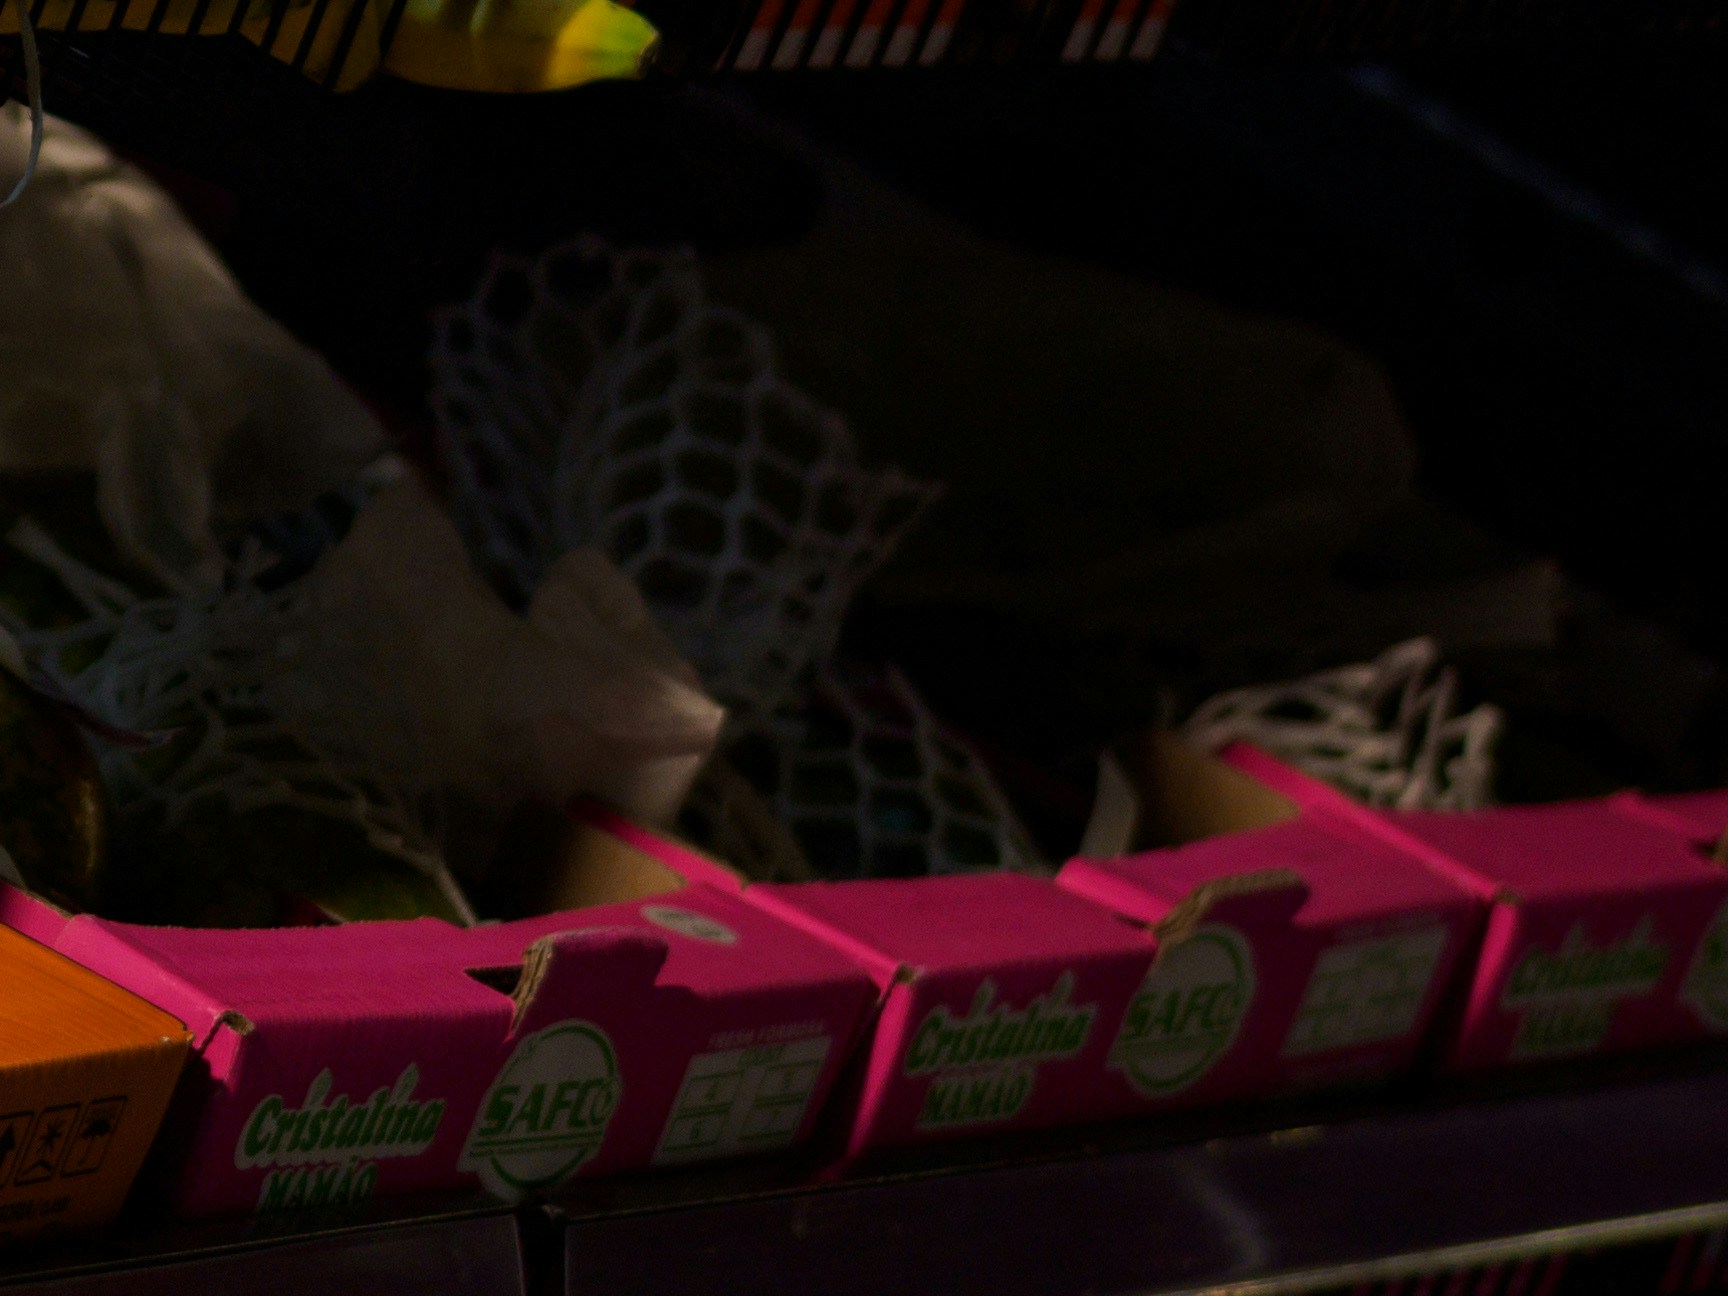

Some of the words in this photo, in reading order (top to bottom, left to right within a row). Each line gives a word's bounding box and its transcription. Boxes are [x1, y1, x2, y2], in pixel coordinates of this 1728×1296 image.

[906, 971, 1096, 1070] Cristalina
[241, 1064, 447, 1162] Cristalina
[479, 1077, 613, 1136] SAFCO
